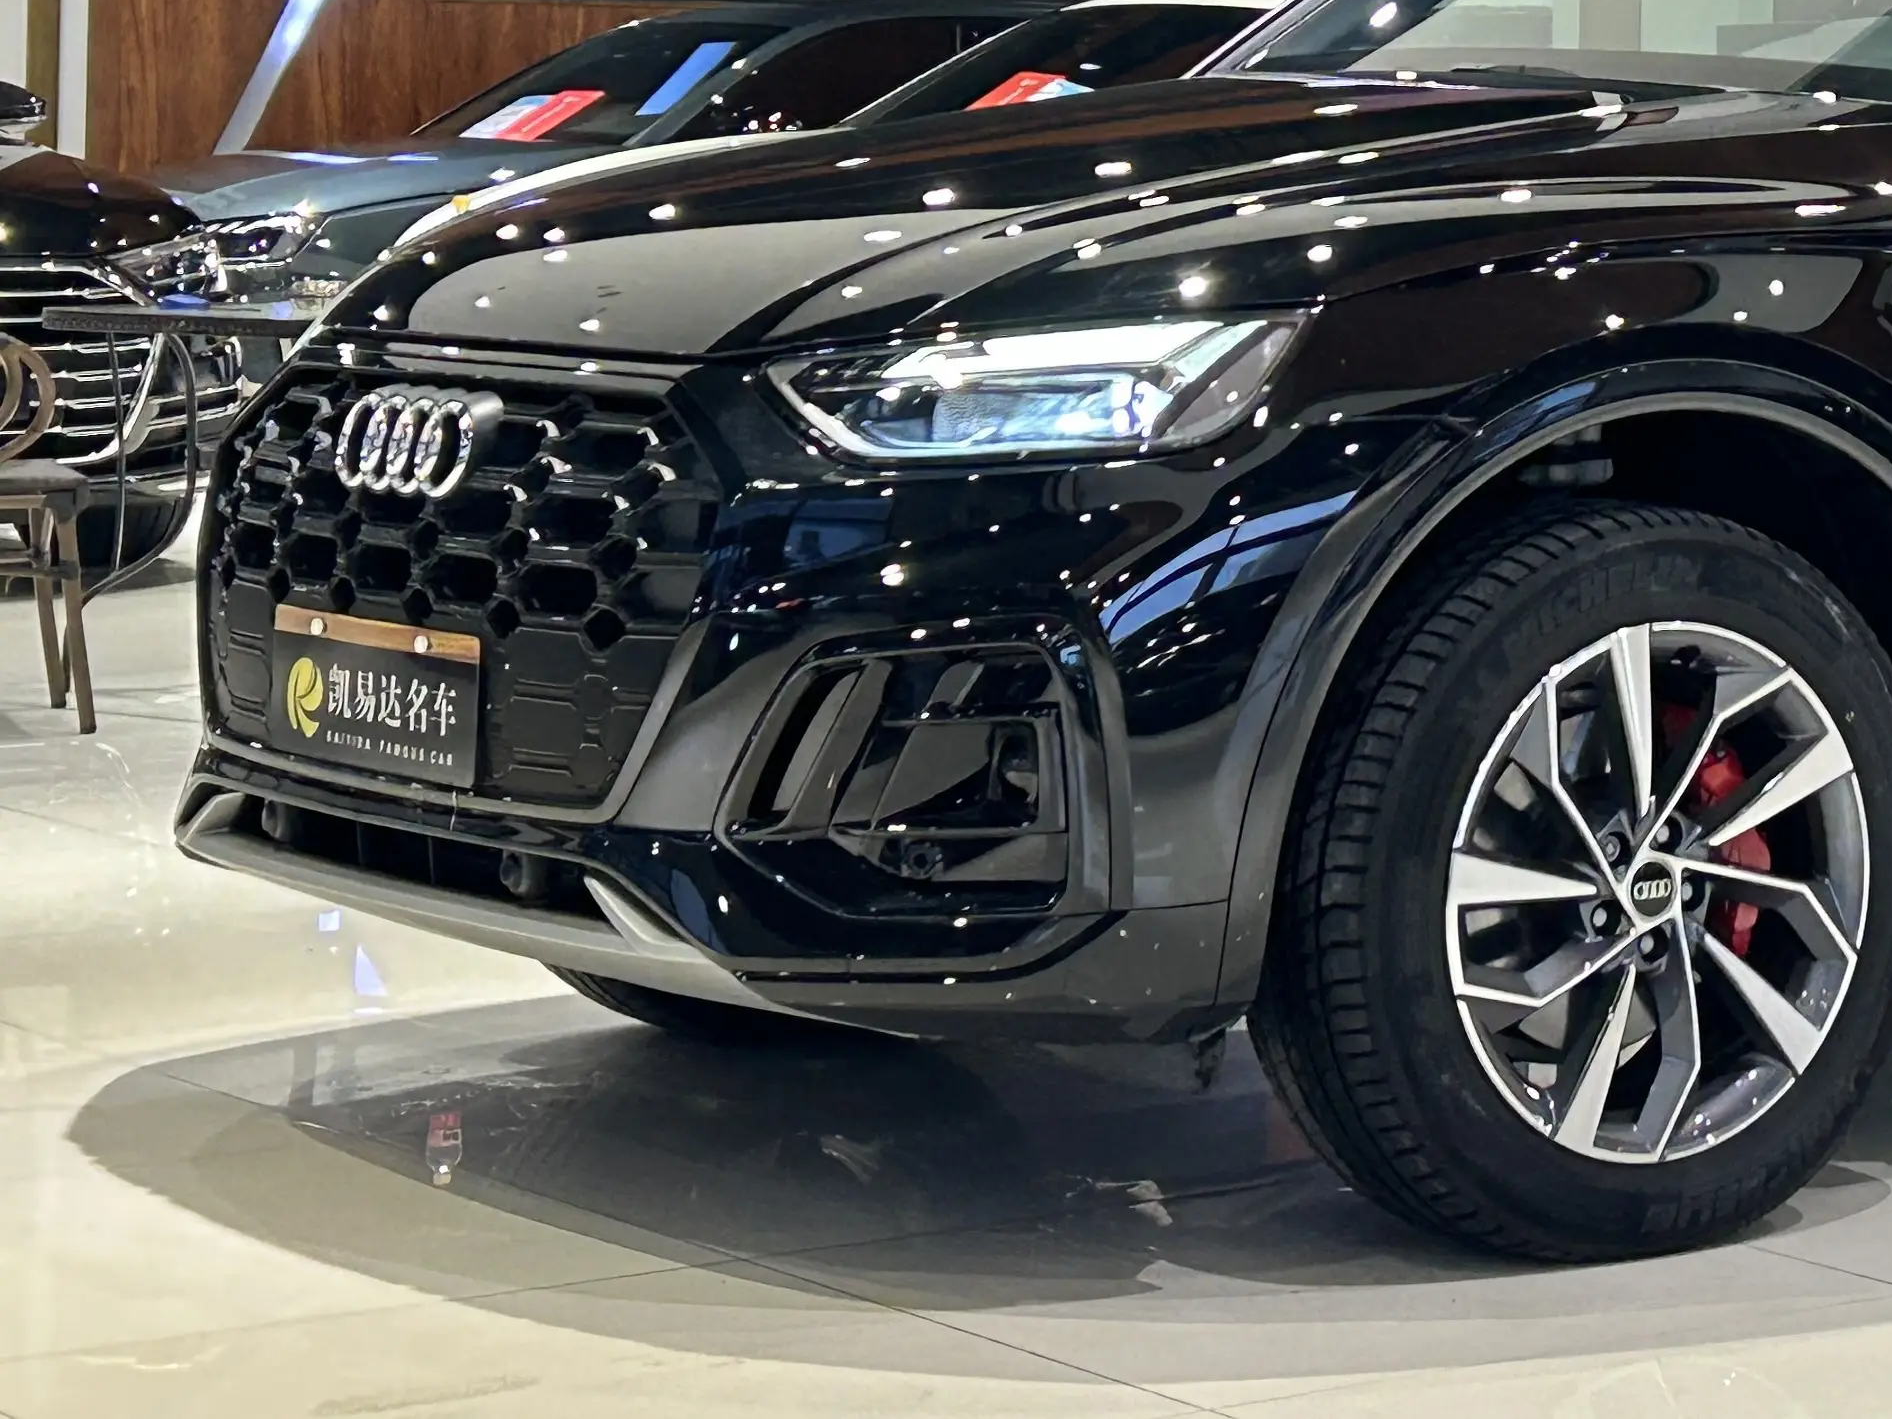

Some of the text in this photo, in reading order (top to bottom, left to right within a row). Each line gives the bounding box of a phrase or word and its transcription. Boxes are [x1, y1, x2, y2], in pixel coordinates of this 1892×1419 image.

[327, 663, 457, 737] 凯易达名车
